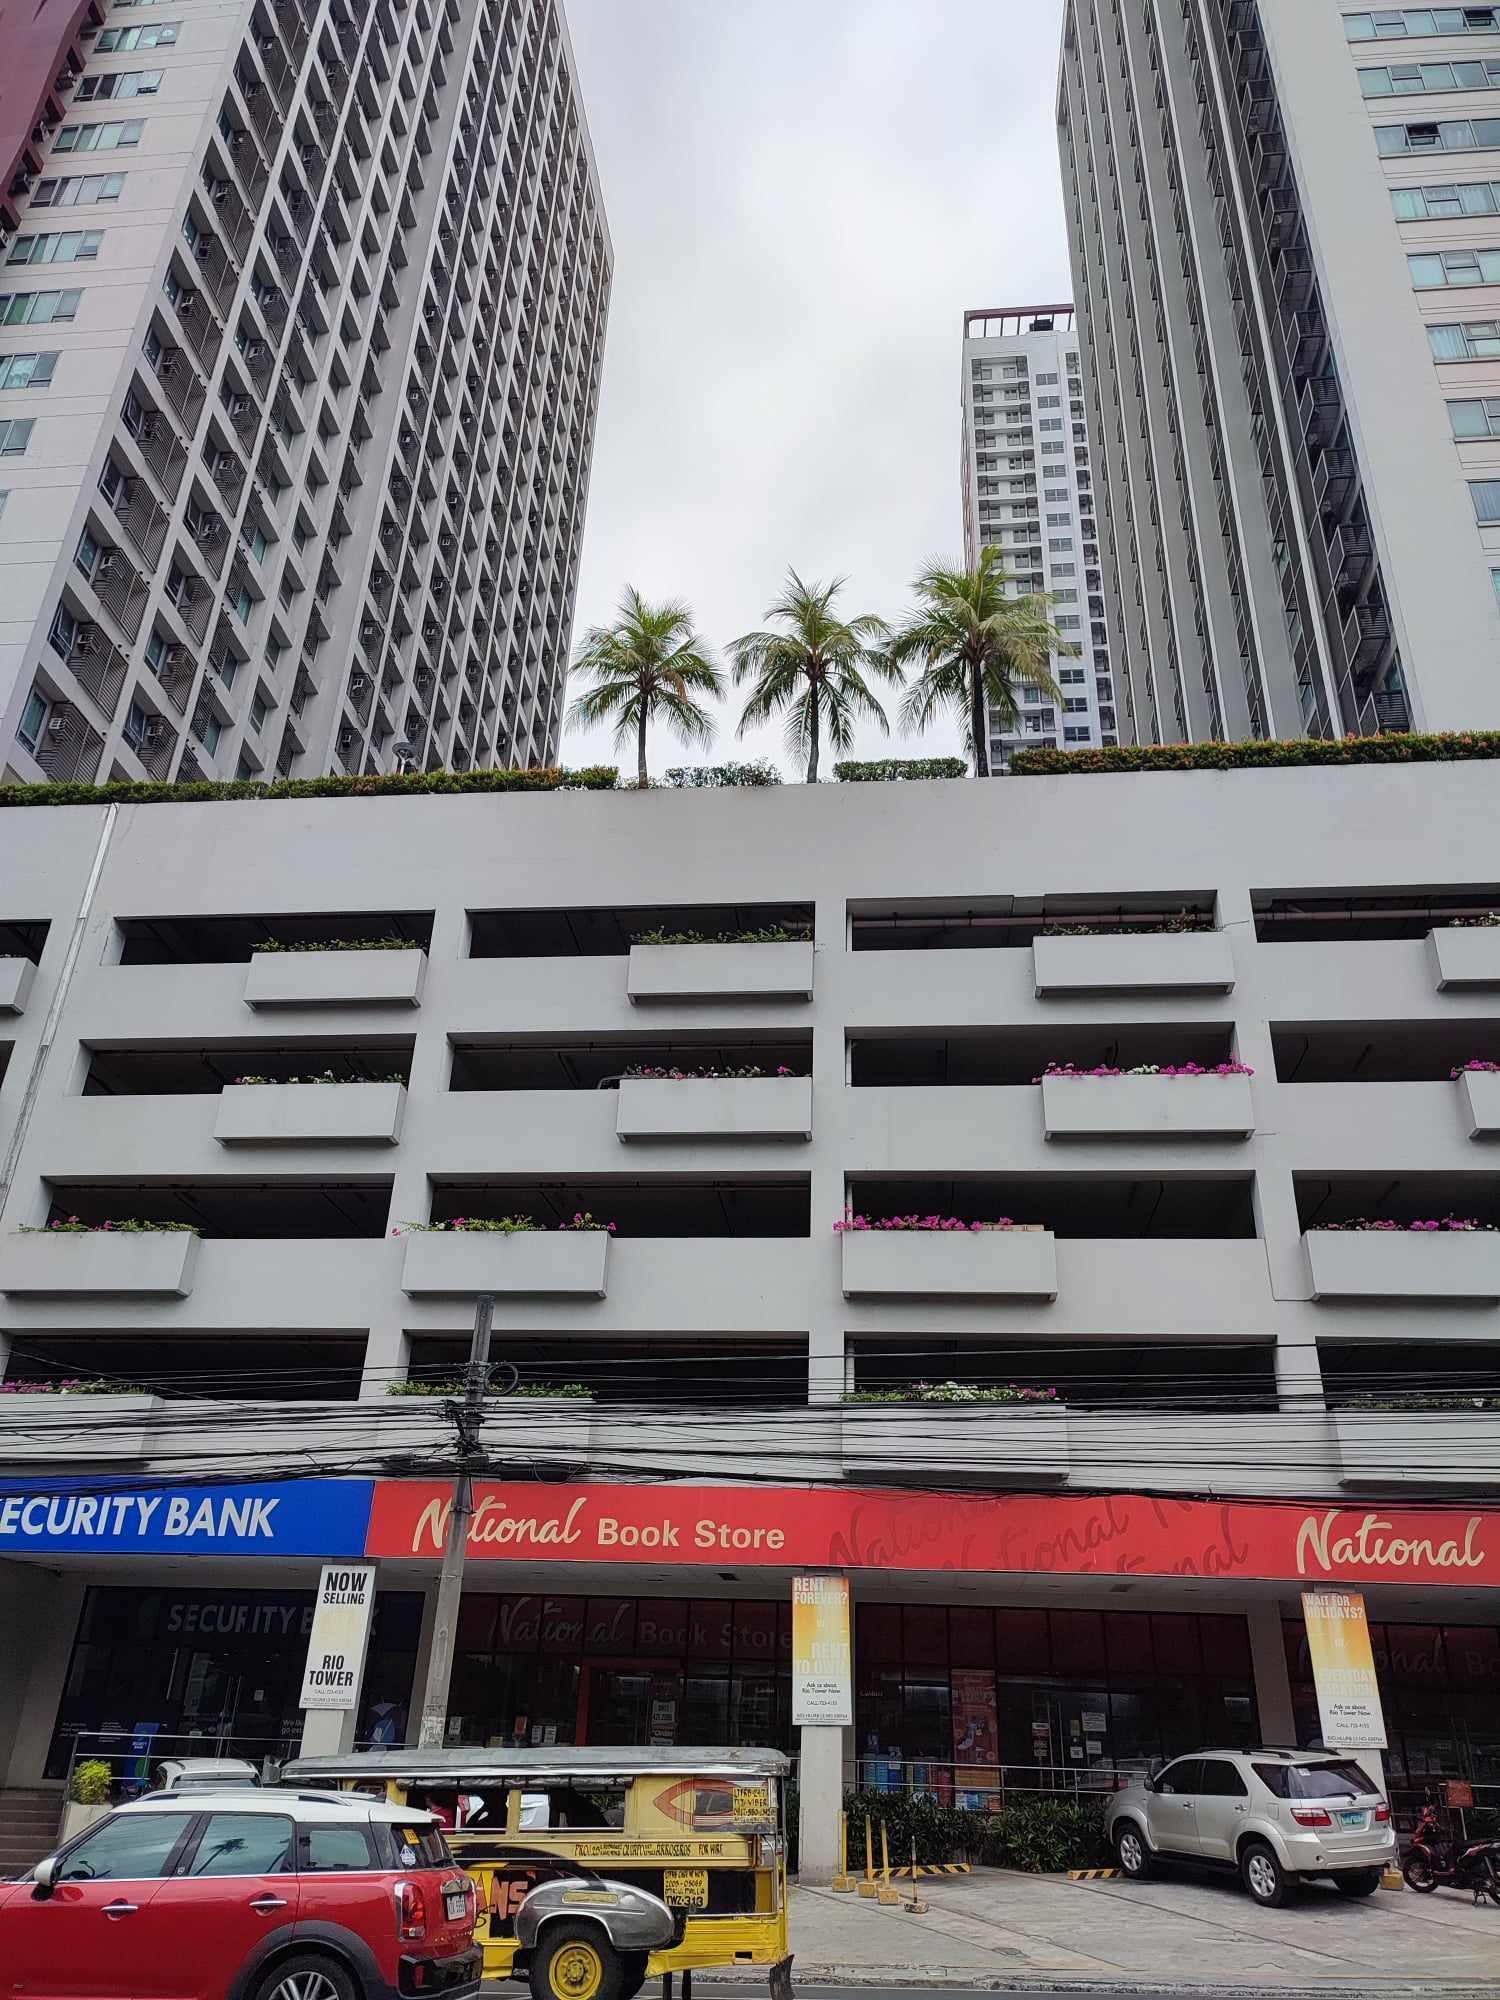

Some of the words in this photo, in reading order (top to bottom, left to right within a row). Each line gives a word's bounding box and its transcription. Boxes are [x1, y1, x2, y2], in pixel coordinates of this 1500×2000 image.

[0, 1496, 161, 1536] ECURITY
[164, 1498, 280, 1537] BANK
[412, 1495, 587, 1553] Ntional
[597, 1517, 681, 1547] Book
[694, 1519, 785, 1550] Store
[1296, 1508, 1486, 1574] National
[325, 1572, 368, 1592] NOW
[793, 1578, 825, 1592] RENT
[323, 1592, 365, 1605] SELLING
[793, 1591, 848, 1605] FOREVER?
[1304, 1594, 1329, 1607] WAIT
[1331, 1595, 1350, 1607] FOR
[1306, 1606, 1363, 1619] HOLIDAYS?
[322, 1655, 345, 1670] RIO
[309, 1670, 354, 1686] TOWER
[1340, 1709, 1357, 1717] Tower
